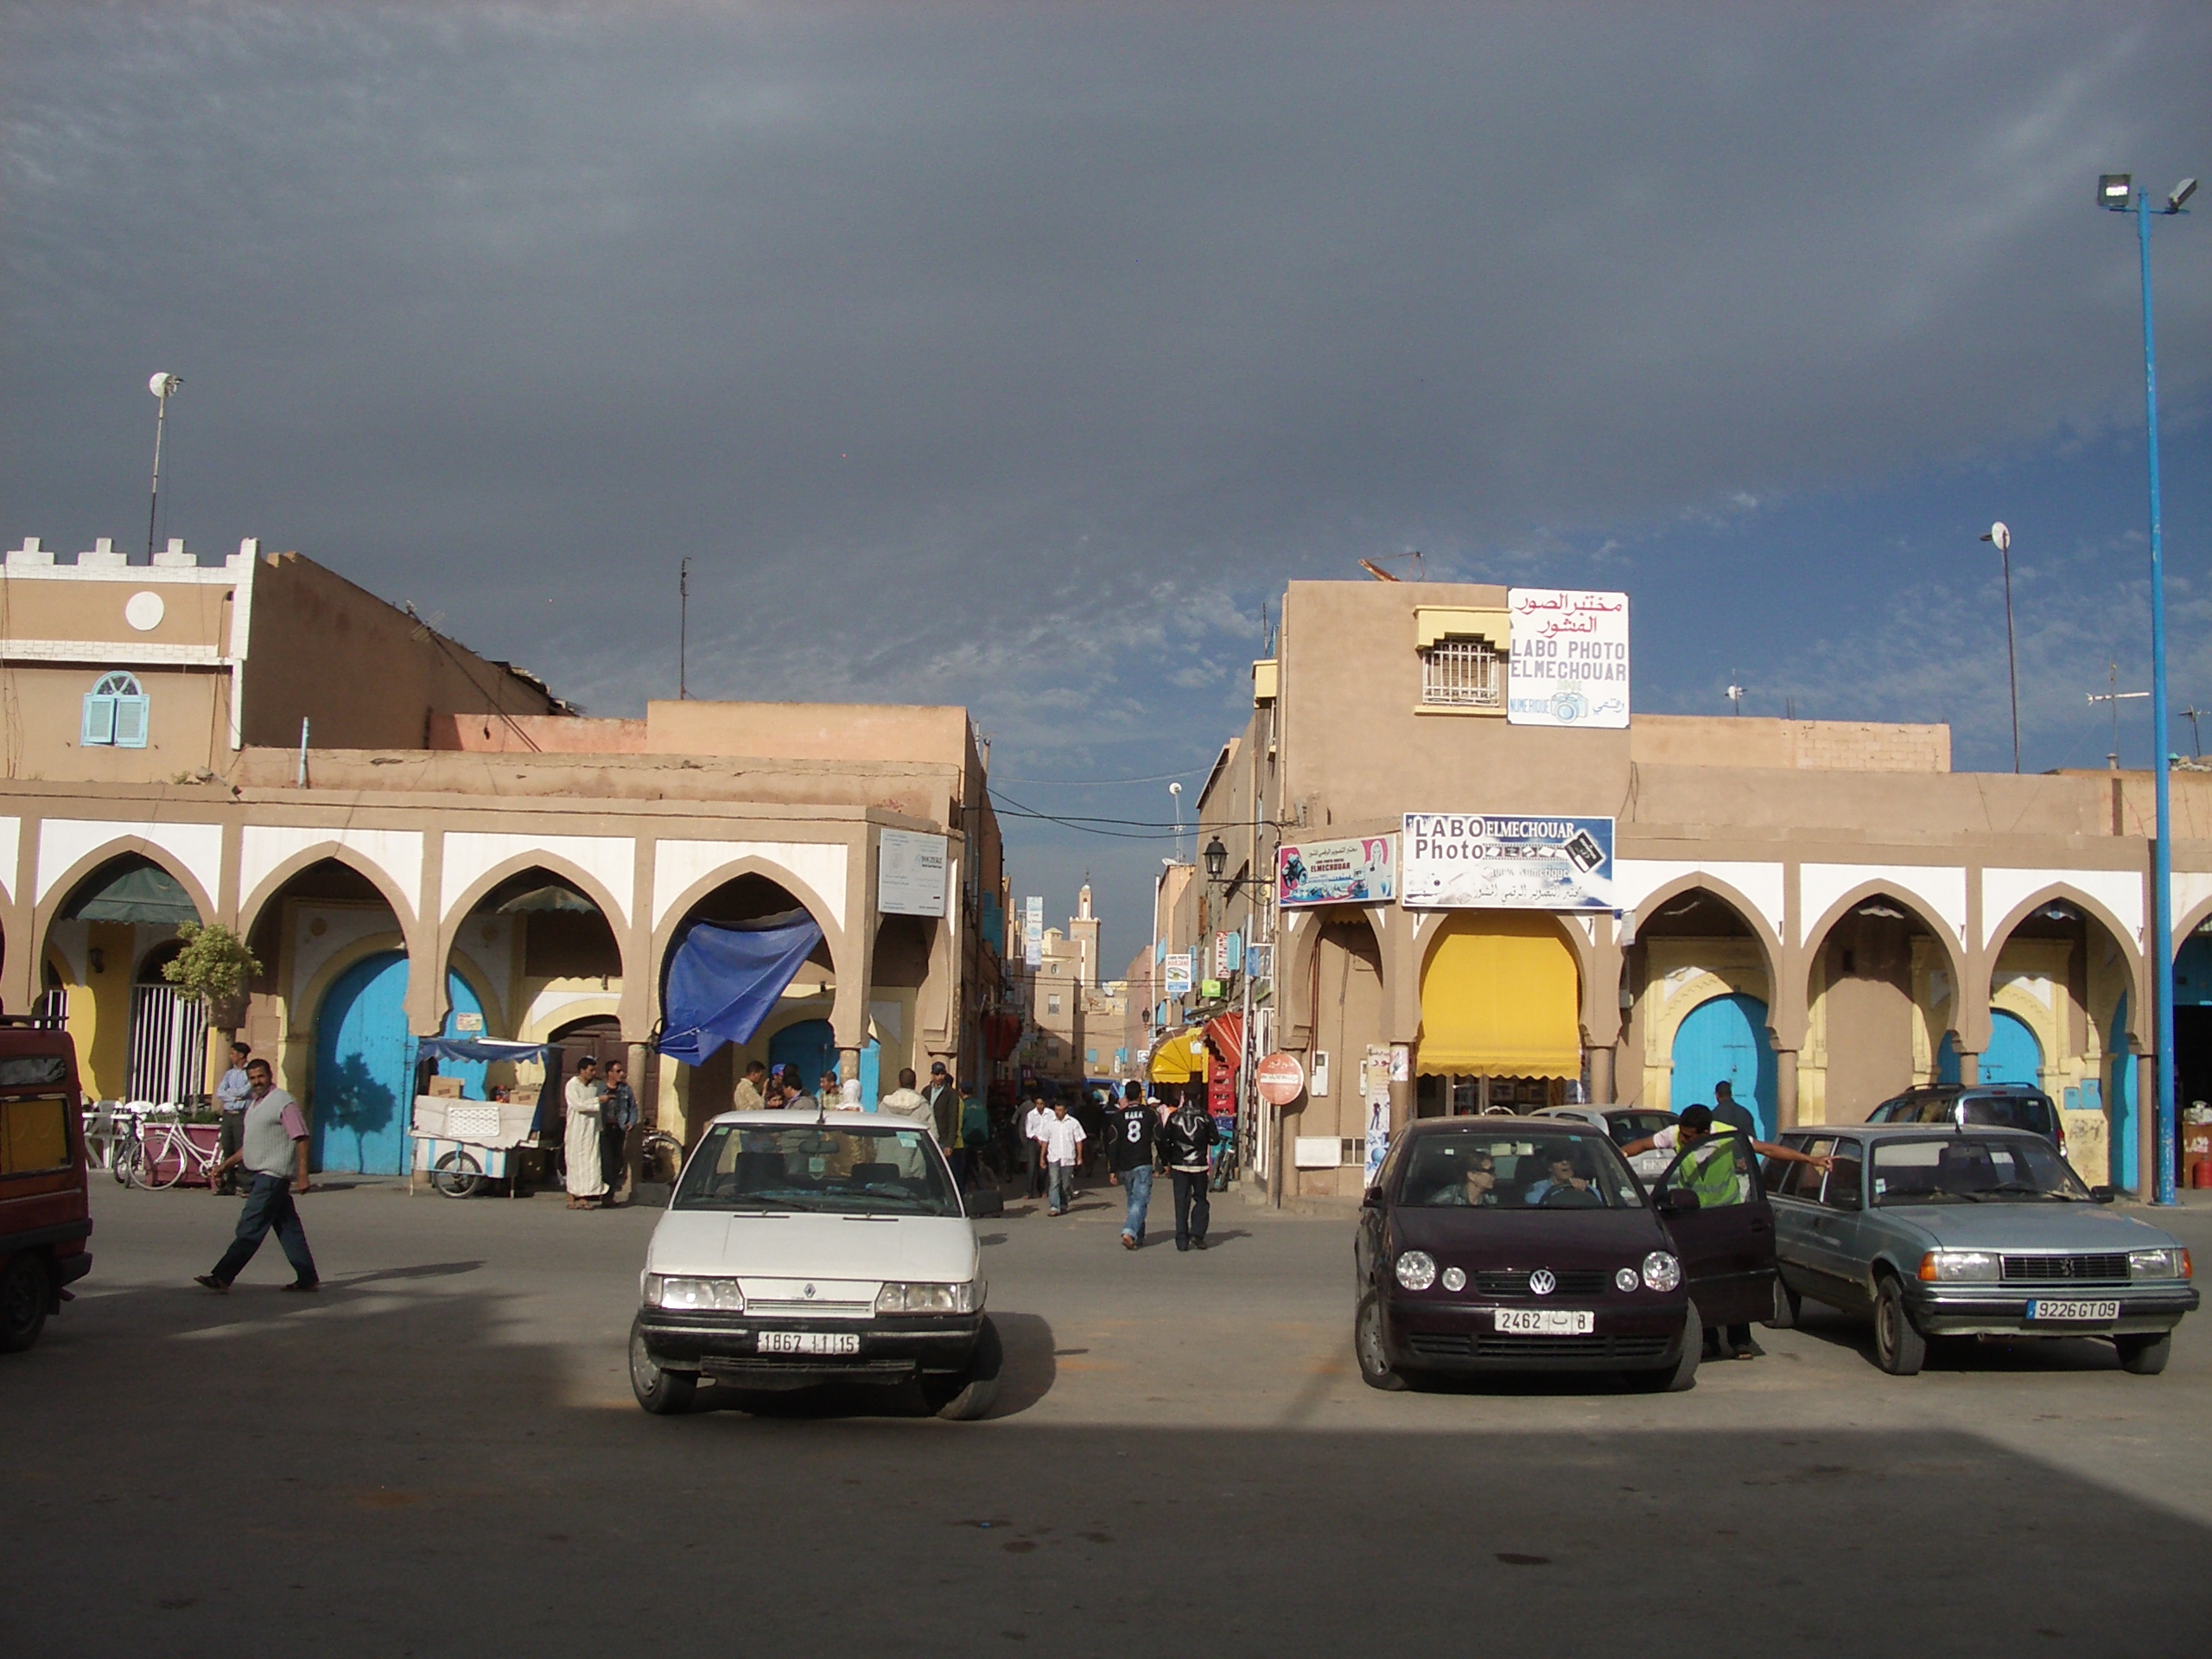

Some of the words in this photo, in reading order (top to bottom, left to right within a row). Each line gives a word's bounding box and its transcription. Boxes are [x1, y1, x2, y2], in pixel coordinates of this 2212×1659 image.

[1514, 593, 1568, 615] الصور
[1562, 594, 1623, 616] مختبر
[1512, 639, 1558, 658] LABO
[1568, 641, 1625, 660] PHOTO
[1510, 660, 1626, 681] ELMECHOUAR
[1510, 698, 1551, 714] NUMERIQUE
[1415, 819, 1484, 837] LABO
[1485, 821, 1574, 838] ELMECHOUAR
[1415, 840, 1484, 860] Photo
[1310, 862, 1351, 873] ELMECHOUAR
[1128, 1120, 1141, 1142] 8
[1502, 1313, 1541, 1329] 2462
[1577, 1313, 1586, 1330] 8
[765, 1333, 802, 1351] 1867
[840, 1335, 855, 1352] 15
